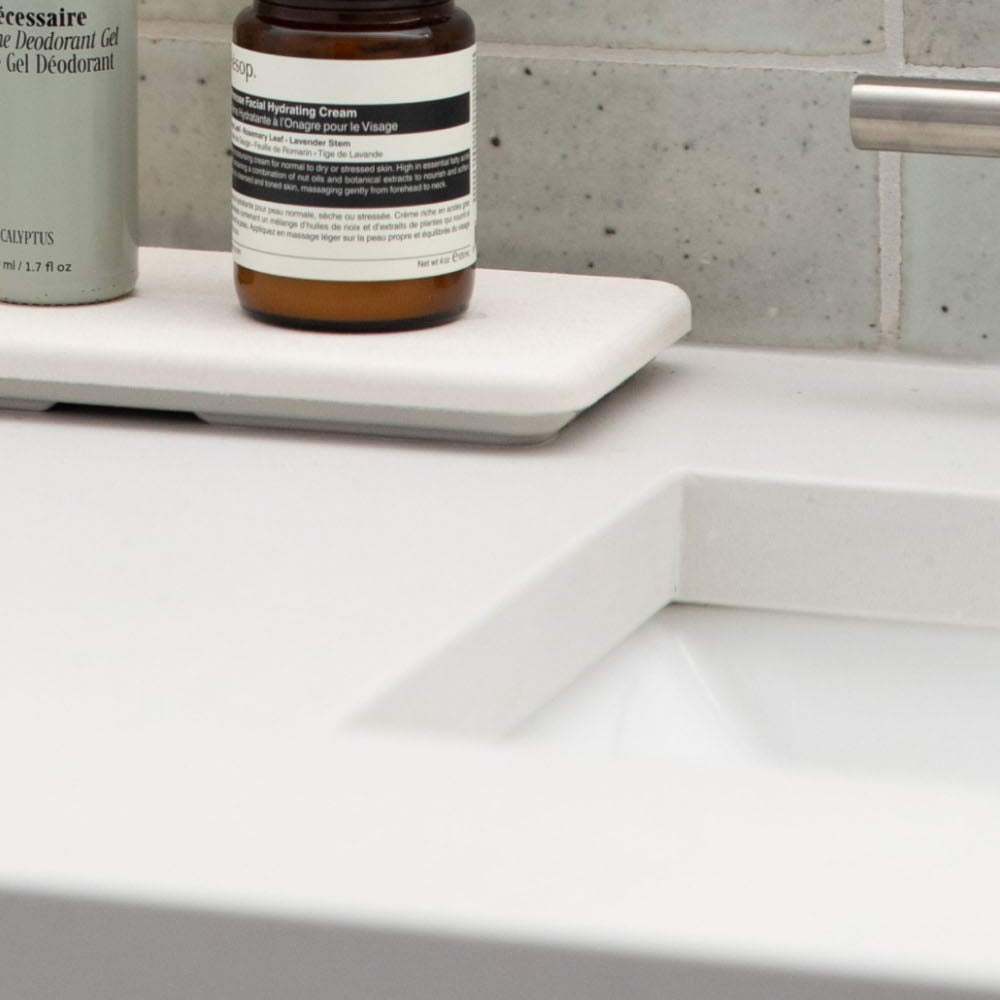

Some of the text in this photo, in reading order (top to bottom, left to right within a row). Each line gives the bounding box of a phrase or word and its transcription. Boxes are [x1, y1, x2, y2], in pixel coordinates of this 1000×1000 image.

[15, 30, 96, 51] Deodorant
[101, 26, 119, 48] Gel
[7, 52, 29, 73] Gel
[37, 53, 115, 74] Déodorant
[267, 101, 316, 119] Hydrating
[319, 107, 357, 118] Cream
[280, 117, 321, 132] l'Onagre
[323, 123, 348, 133] pour
[350, 121, 360, 132] le
[361, 121, 399, 134] Visage
[289, 137, 326, 147] Lavender
[328, 138, 351, 147] Stem
[320, 150, 335, 160] Tige
[337, 150, 347, 158] de
[349, 150, 384, 159] Lavande
[281, 161, 305, 171] normal
[306, 164, 315, 172] to
[316, 164, 329, 174] dry
[341, 165, 375, 173] stressed
[396, 163, 414, 173] High
[297, 174, 310, 182] nut
[311, 175, 325, 183] oils
[327, 175, 343, 184] and
[344, 175, 382, 184] botanical
[383, 173, 413, 183] extracts
[301, 185, 343, 196] massaging
[344, 186, 370, 196] gently
[370, 186, 389, 195] from
[3, 260, 16, 270] ml
[18, 260, 22, 271] /
[26, 261, 42, 272] 1.7
[46, 260, 54, 272] fl
[57, 264, 72, 272] oz
